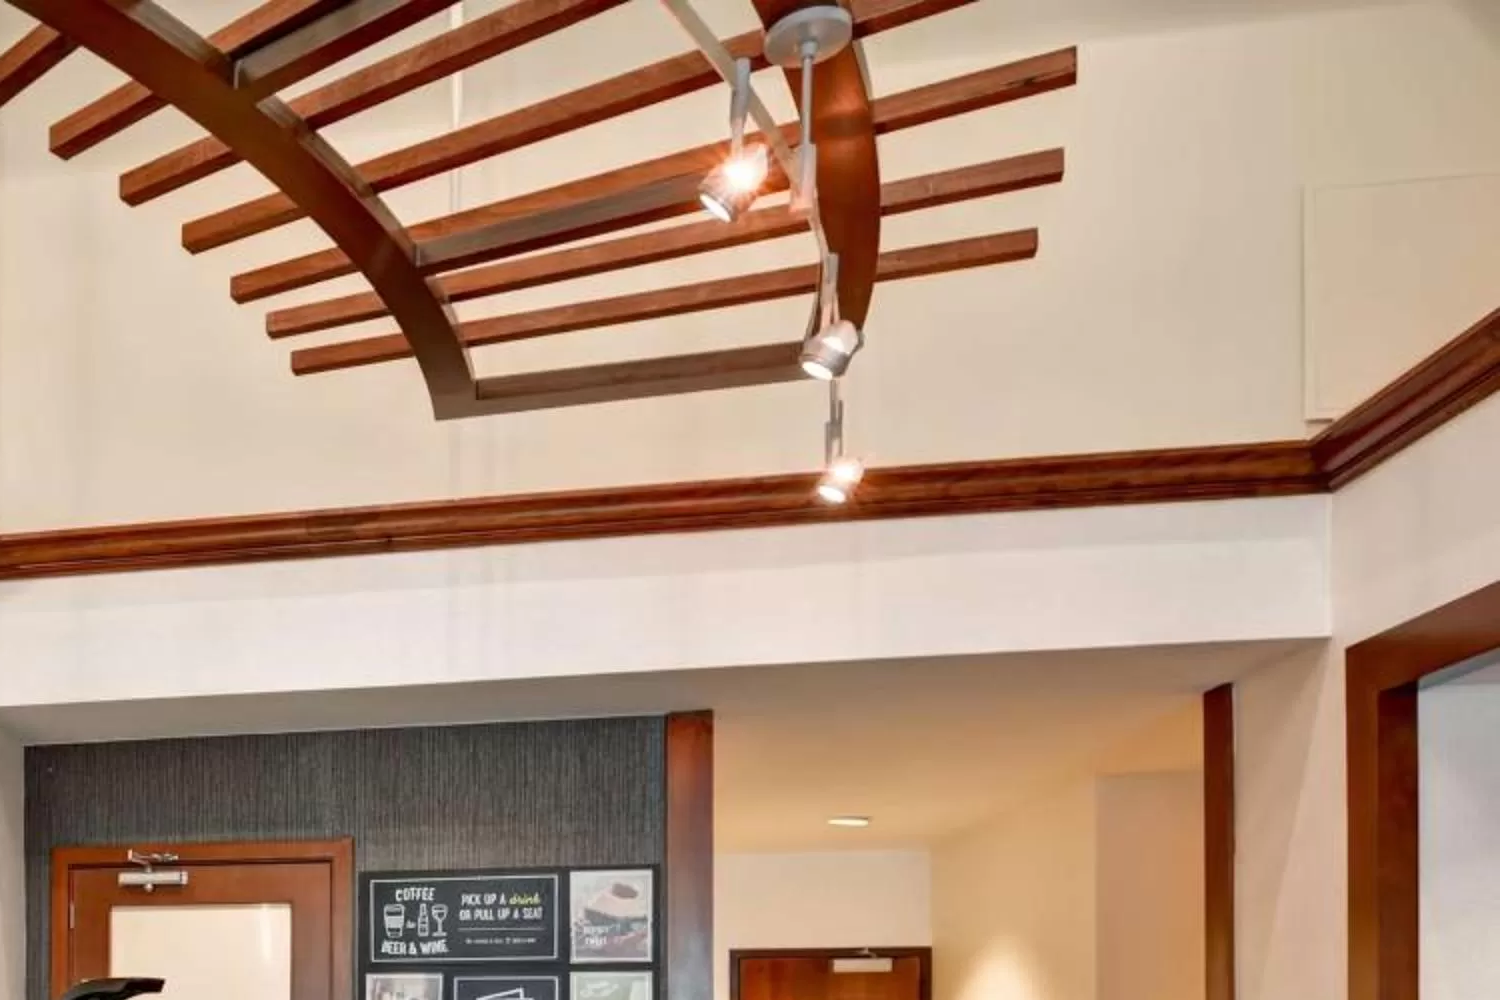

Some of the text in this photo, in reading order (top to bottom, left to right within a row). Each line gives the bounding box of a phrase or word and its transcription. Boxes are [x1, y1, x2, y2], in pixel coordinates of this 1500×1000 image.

[395, 886, 436, 901] COFFEE
[461, 891, 541, 906] PICK UP A drink
[459, 906, 543, 921] OR PULL UP A SEAT
[381, 940, 407, 955] BEER
[408, 942, 418, 955] &
[419, 939, 449, 954] WINE
